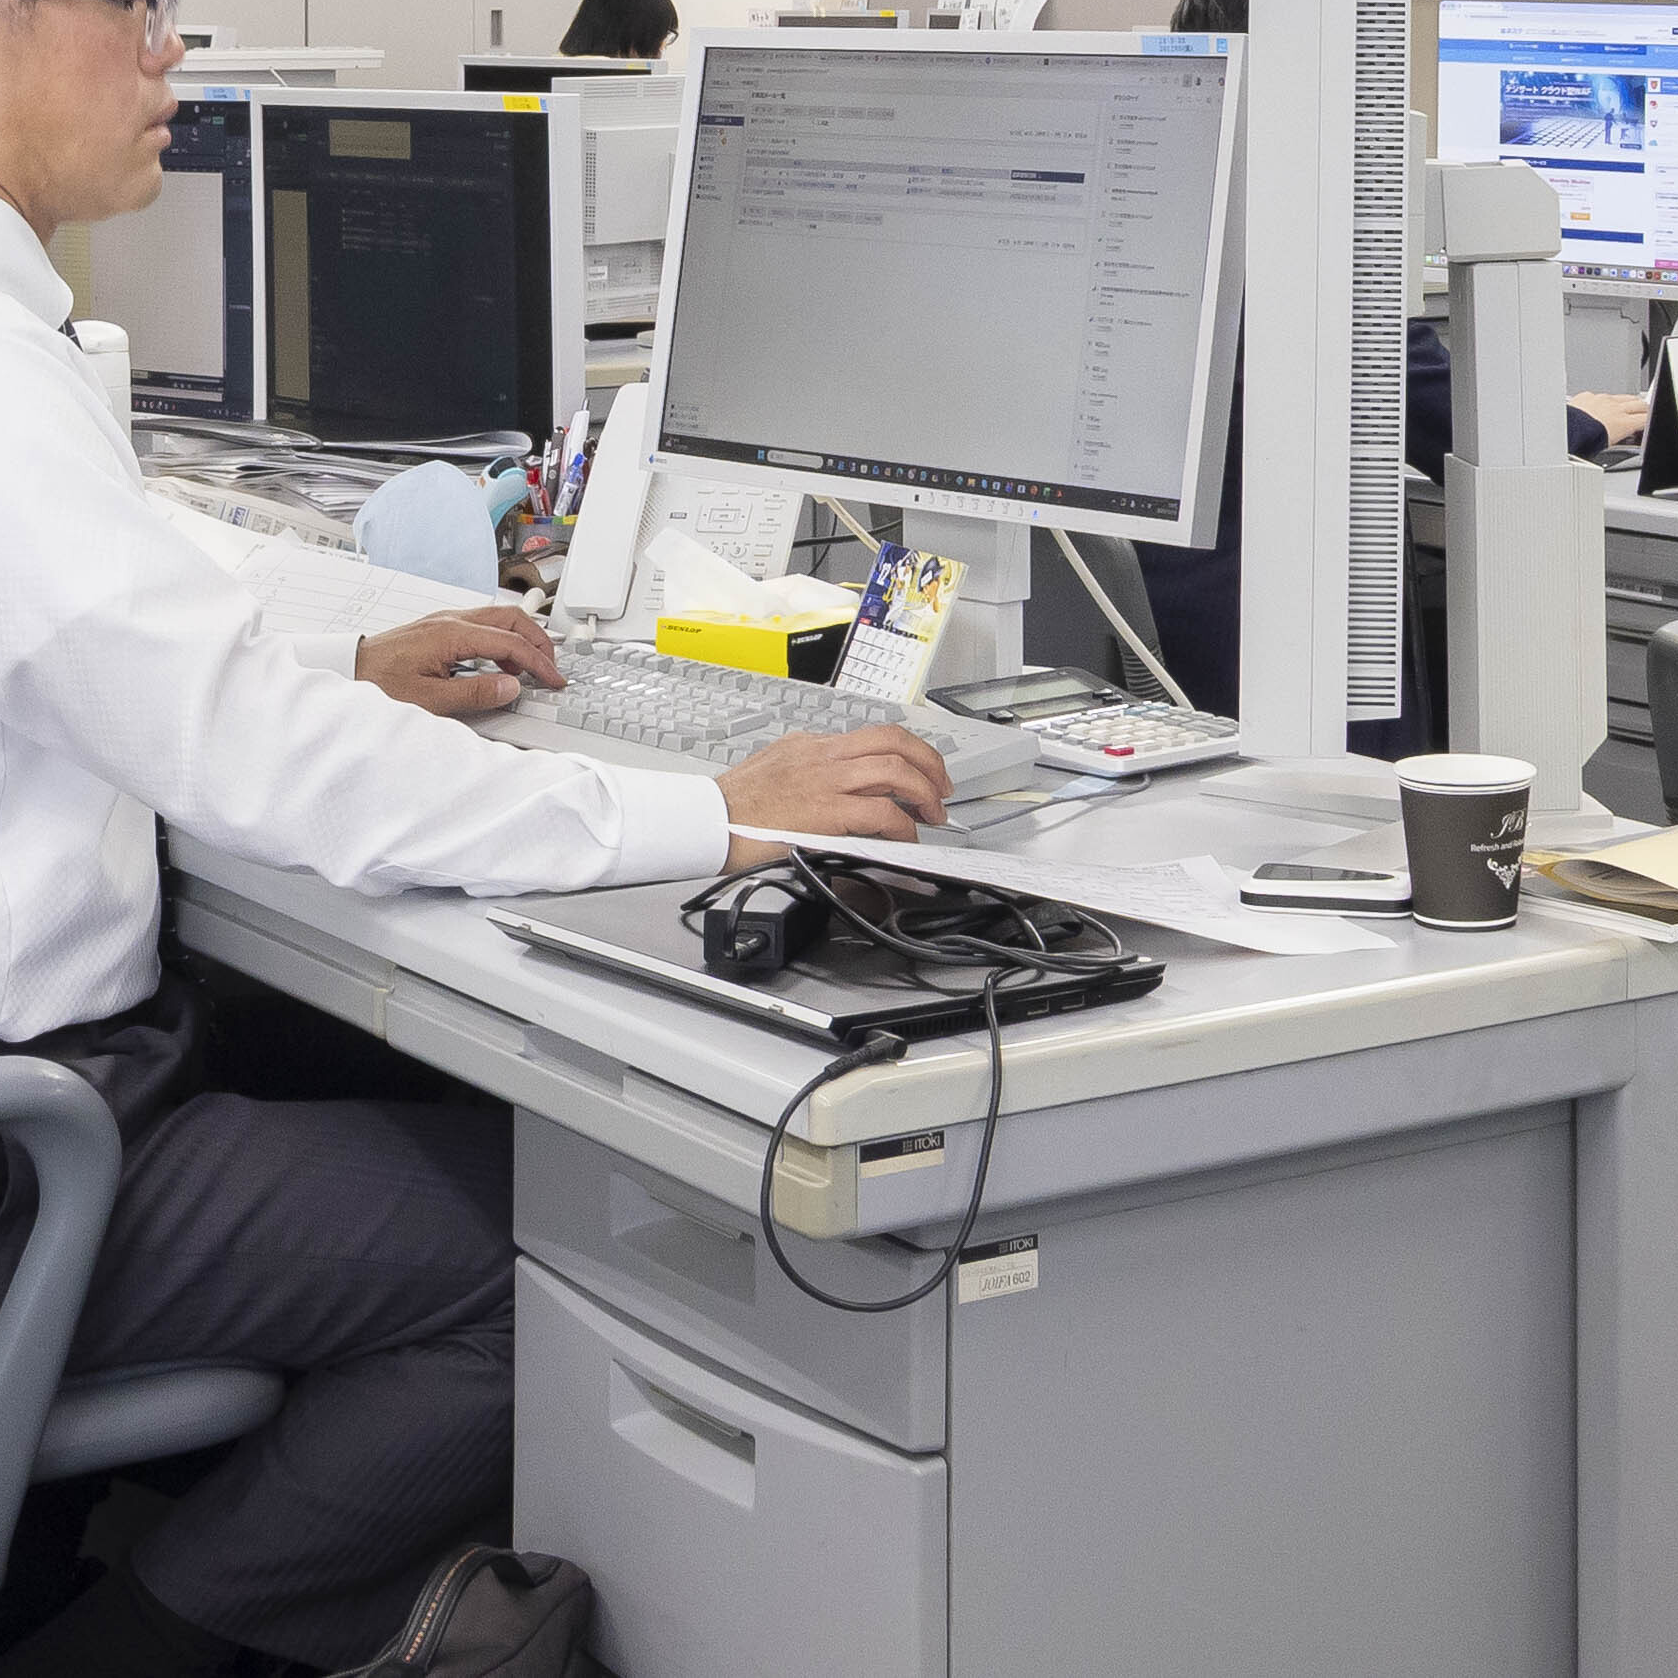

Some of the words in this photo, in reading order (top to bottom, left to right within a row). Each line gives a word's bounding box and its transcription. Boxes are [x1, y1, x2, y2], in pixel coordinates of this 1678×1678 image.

[1470, 843, 1500, 852] Refresh
[914, 1135, 941, 1151] ITOKI
[1009, 1237, 1035, 1252] ITOKI
[1012, 1271, 1031, 1285] 602
